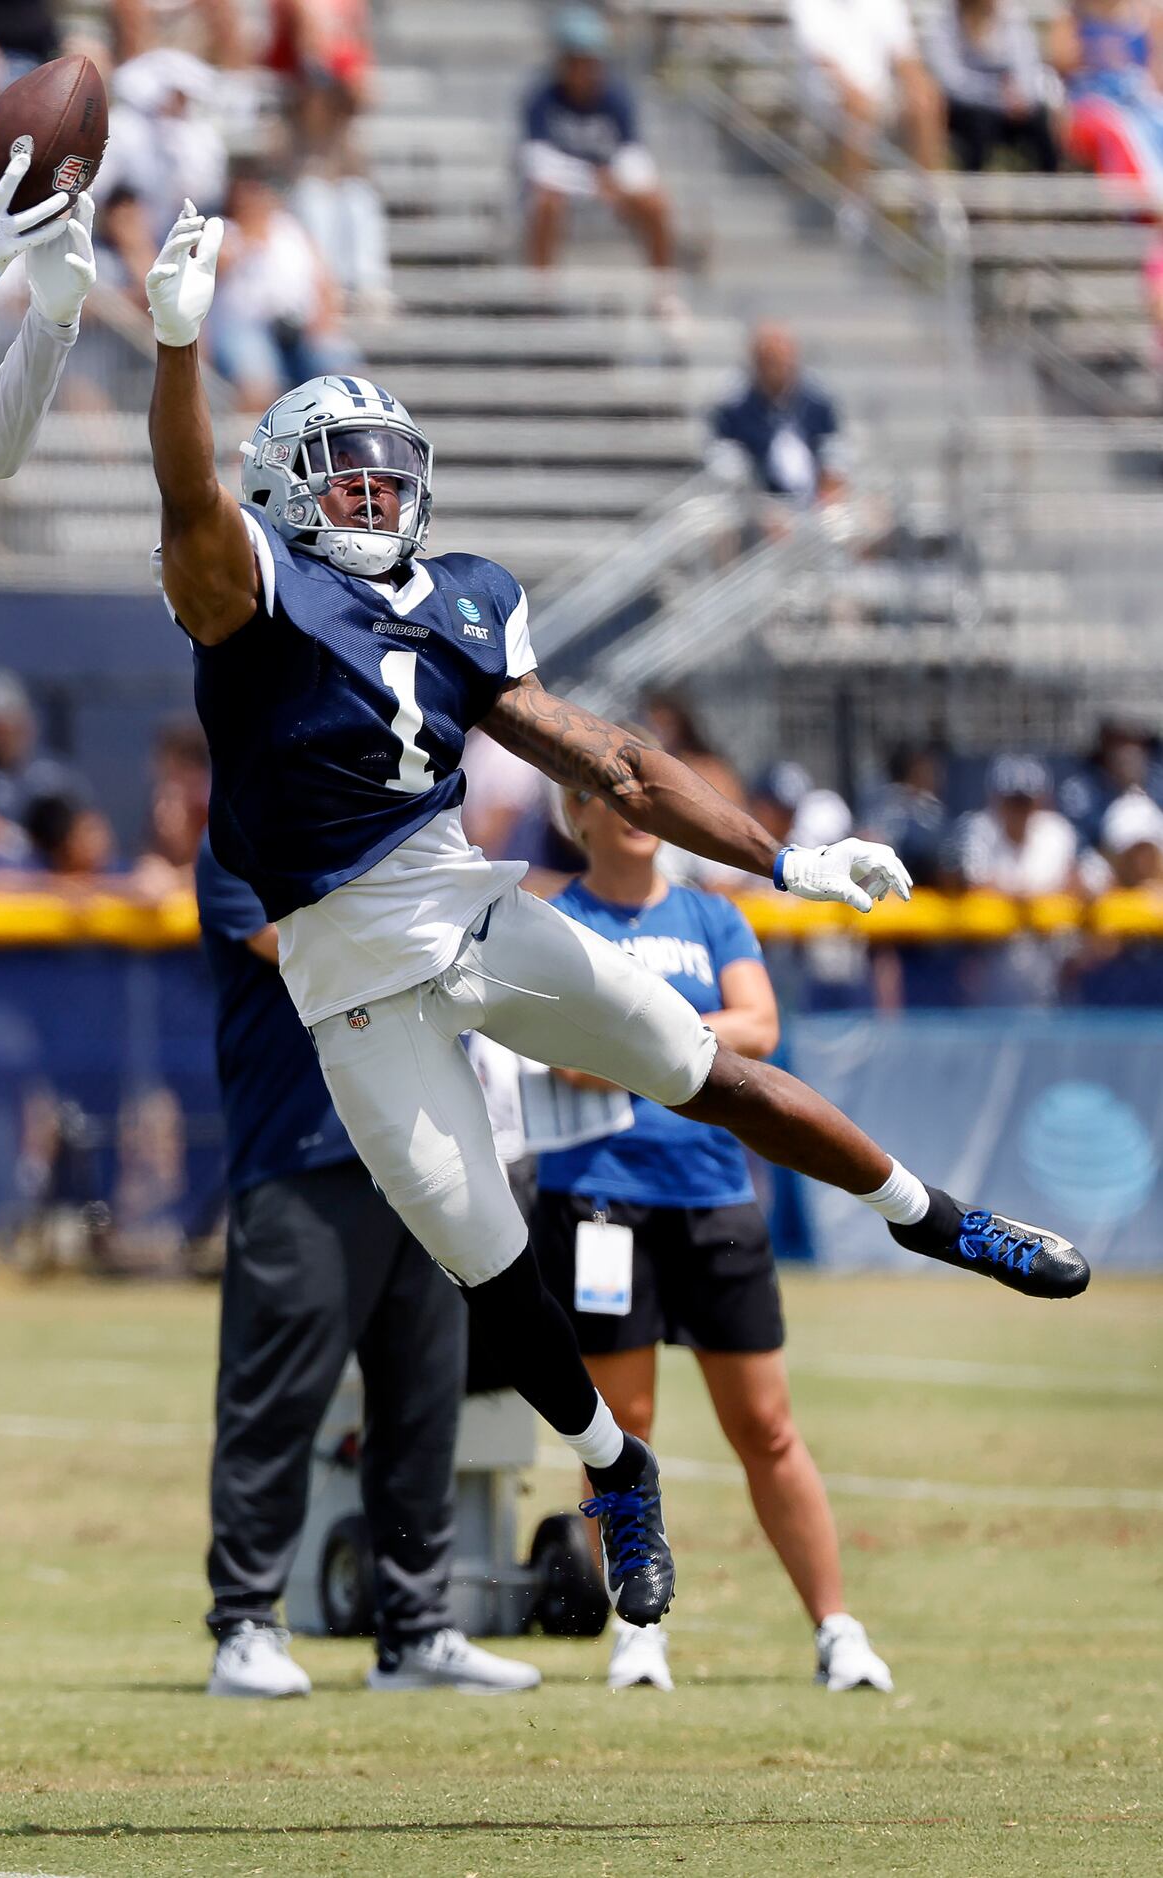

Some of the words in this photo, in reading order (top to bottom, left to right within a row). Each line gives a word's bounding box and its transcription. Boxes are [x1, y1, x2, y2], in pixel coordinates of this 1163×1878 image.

[57, 160, 83, 187] NFL
[373, 621, 430, 639] COWBOYS
[463, 623, 489, 640] AT&T
[379, 650, 435, 794] 1
[614, 935, 714, 988] BOYS
[350, 1016, 368, 1028] NFL
